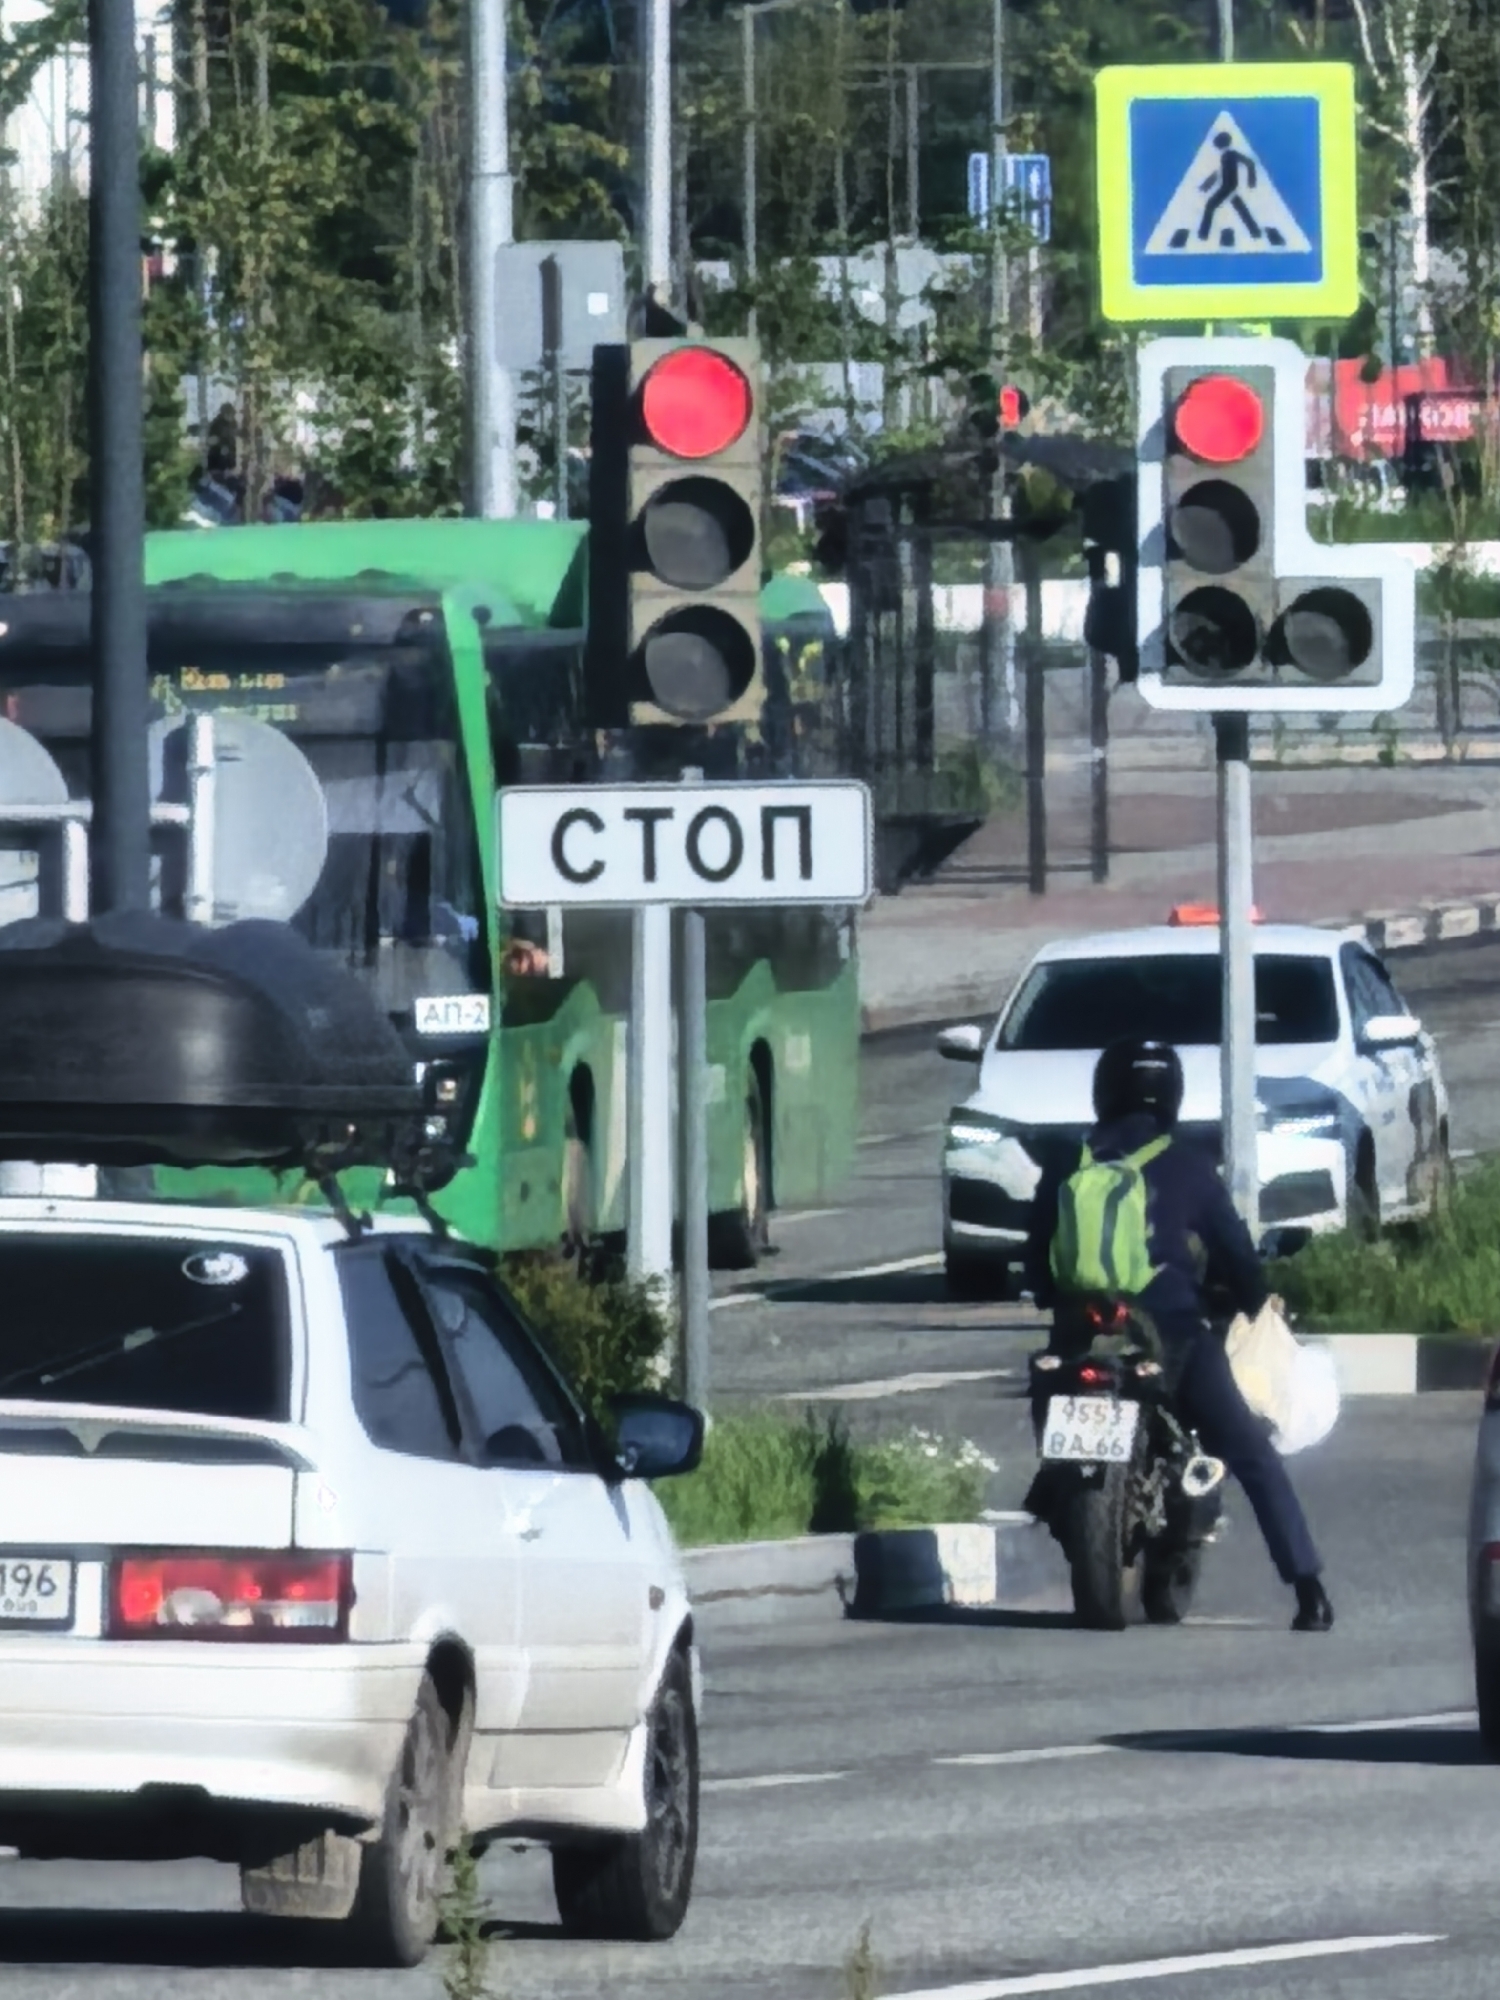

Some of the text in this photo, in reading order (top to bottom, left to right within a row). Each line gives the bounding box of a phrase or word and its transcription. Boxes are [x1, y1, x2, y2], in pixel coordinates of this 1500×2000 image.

[551, 805, 812, 883] СТОП
[424, 1001, 485, 1025] АП-2
[0, 1563, 57, 1598] 196
